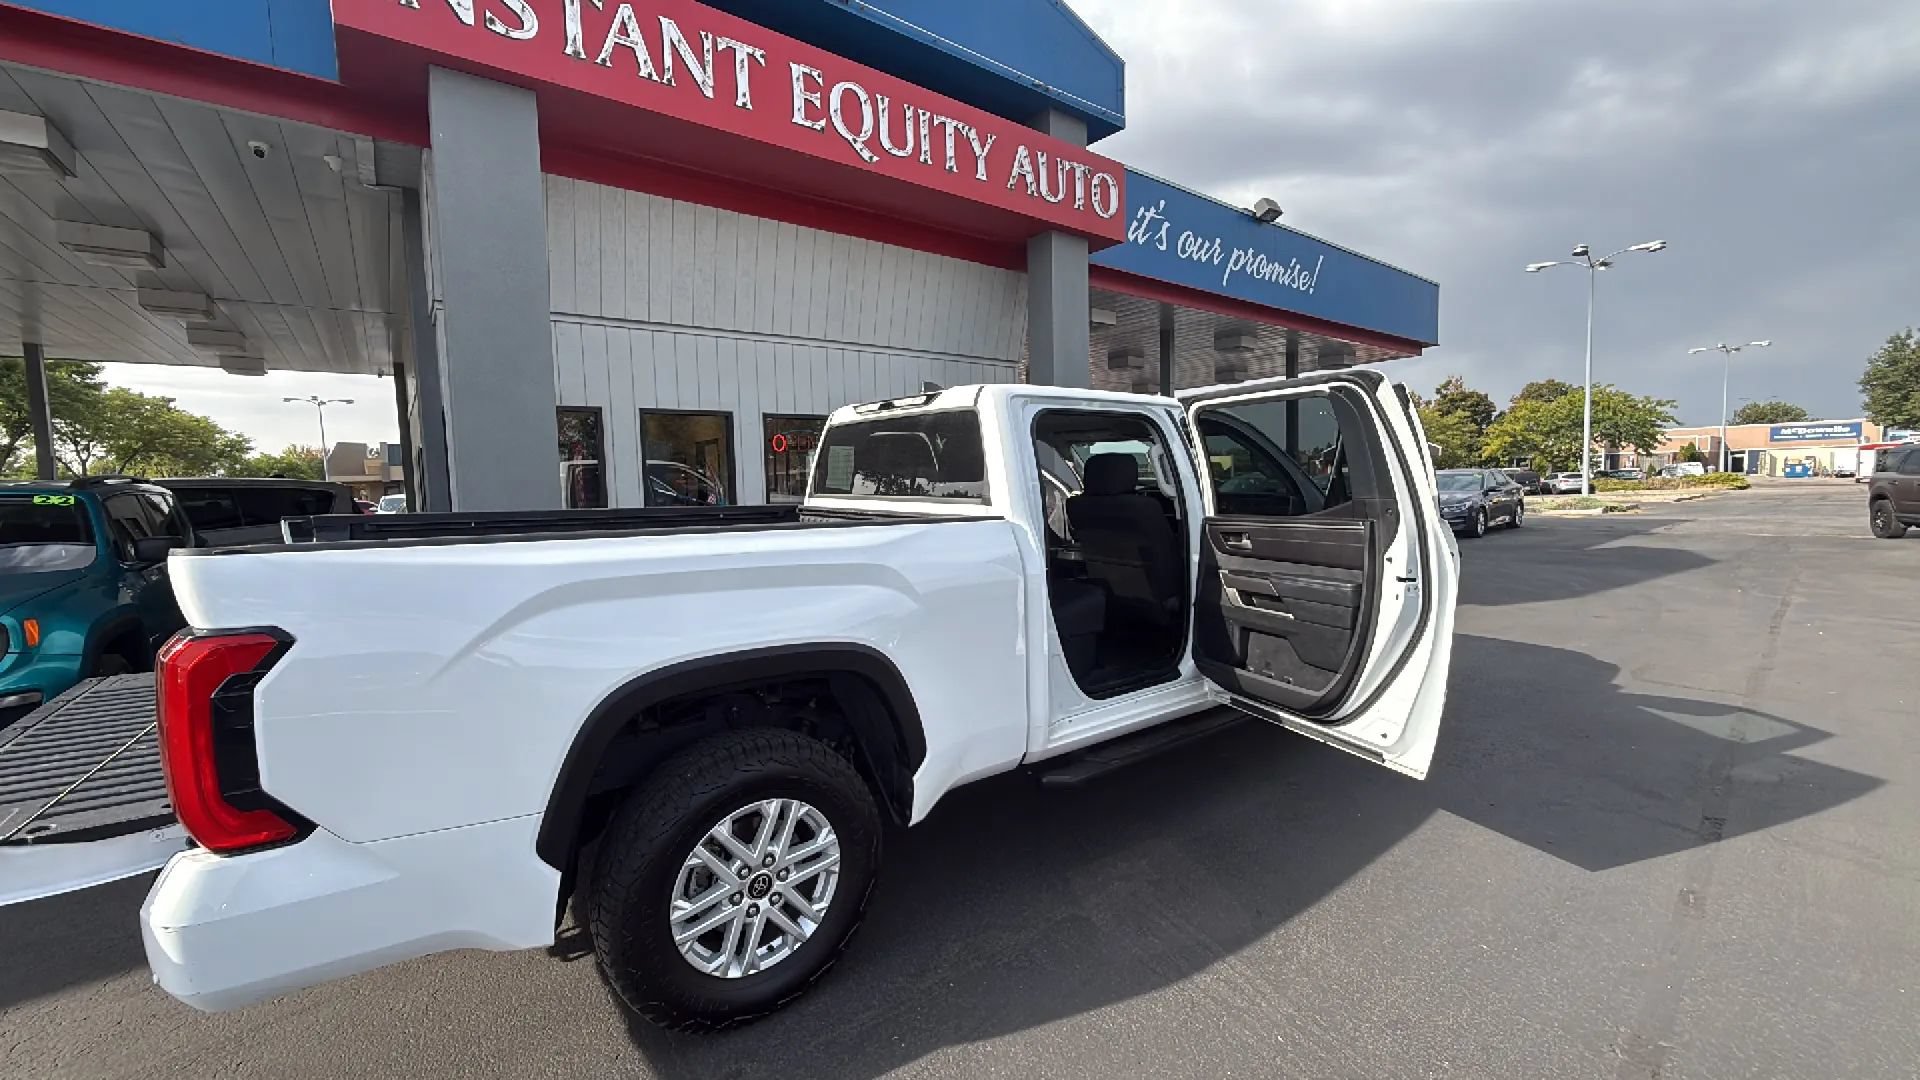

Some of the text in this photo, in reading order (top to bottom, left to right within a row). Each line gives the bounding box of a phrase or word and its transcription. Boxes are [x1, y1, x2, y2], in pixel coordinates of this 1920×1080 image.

[789, 62, 998, 182] EQUITY
[1007, 144, 1120, 219] AUTO
[1126, 199, 1325, 295] it's our promise!
